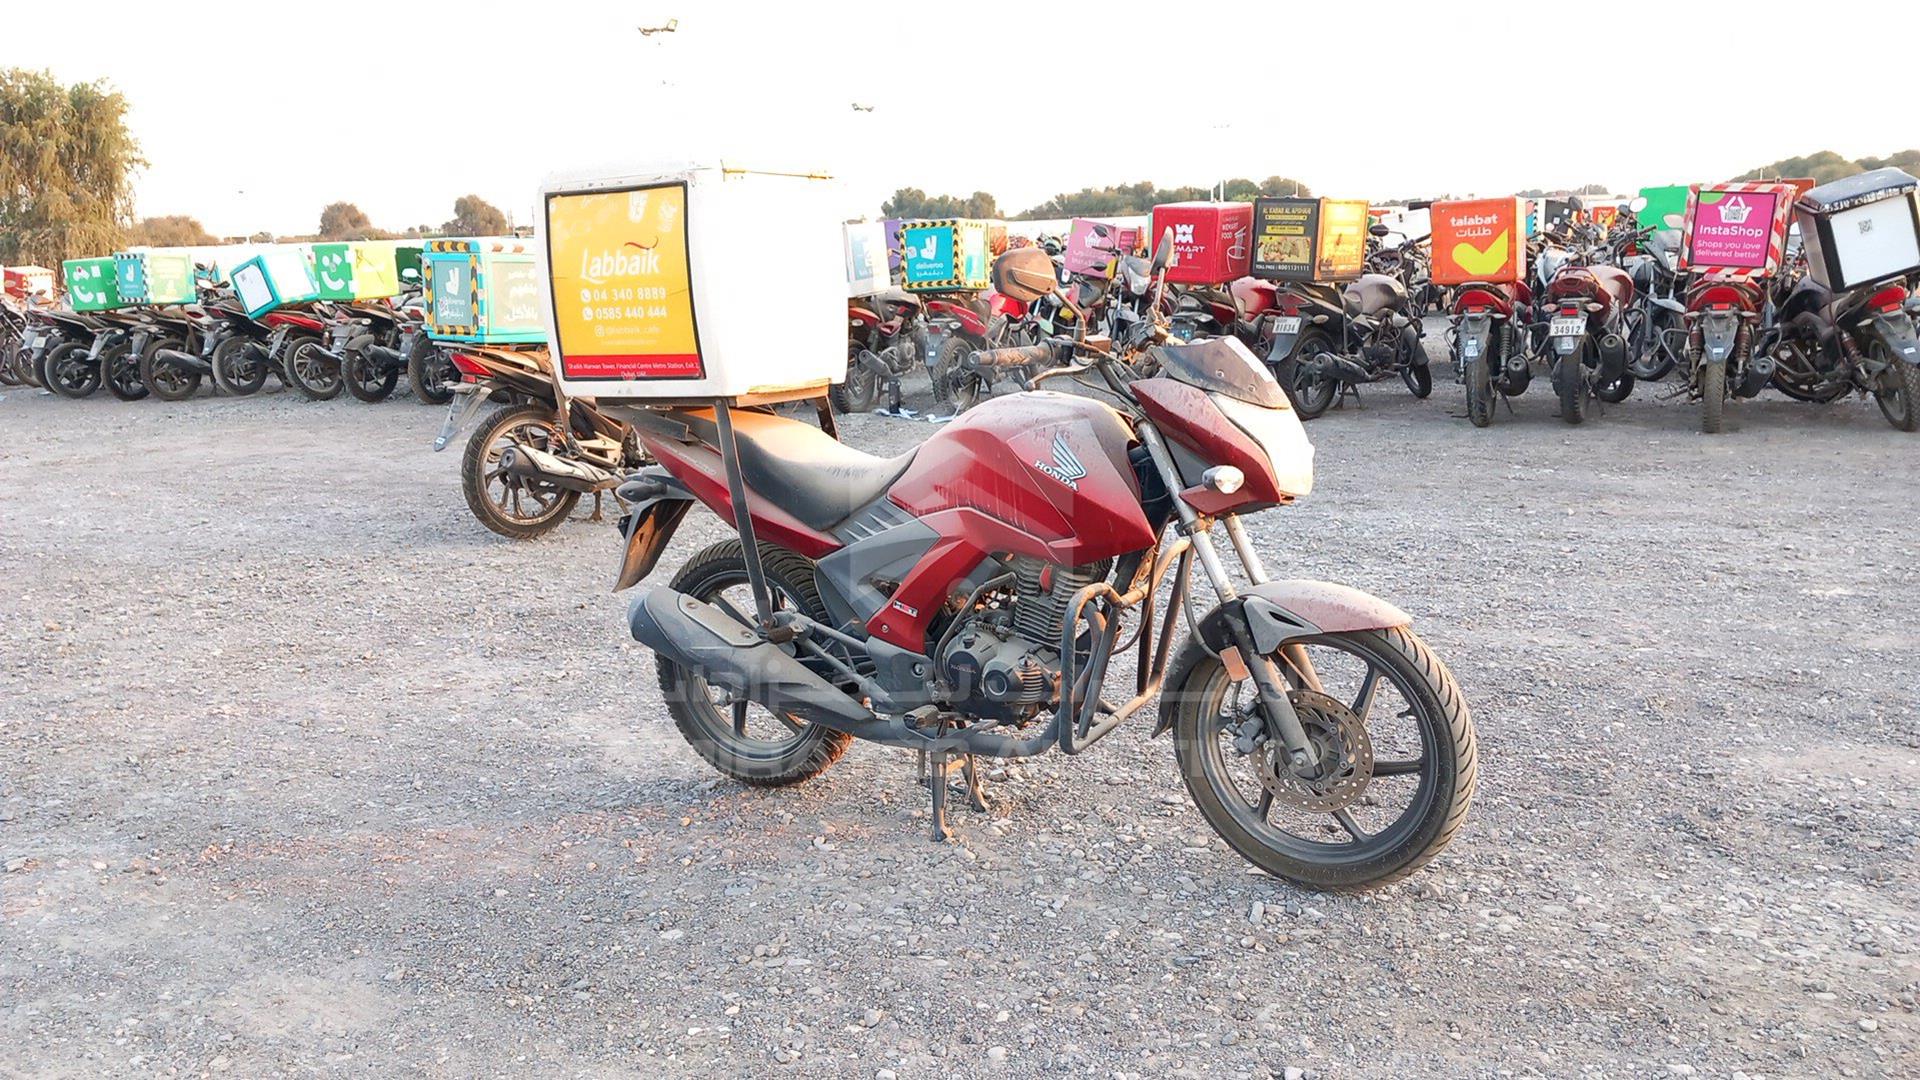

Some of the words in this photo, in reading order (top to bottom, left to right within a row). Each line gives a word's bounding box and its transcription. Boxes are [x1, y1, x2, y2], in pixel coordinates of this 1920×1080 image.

[1450, 214, 1498, 226] talabat
[1455, 227, 1492, 239] طلبات
[1699, 225, 1764, 238] InstaShop
[1697, 240, 1722, 249] Shops
[1725, 242, 1741, 250] you
[1743, 242, 1761, 250] love
[1695, 249, 1733, 258] delivered
[1734, 251, 1760, 259] better
[580, 247, 661, 284] Labbaik
[593, 288, 608, 301] 04
[611, 288, 633, 301] 340
[637, 287, 666, 300] 8889
[595, 306, 622, 320] 0585
[625, 306, 644, 319] 440
[648, 305, 667, 318] 444
[1554, 325, 1581, 335] 34912
[1034, 460, 1080, 493] HONDA
